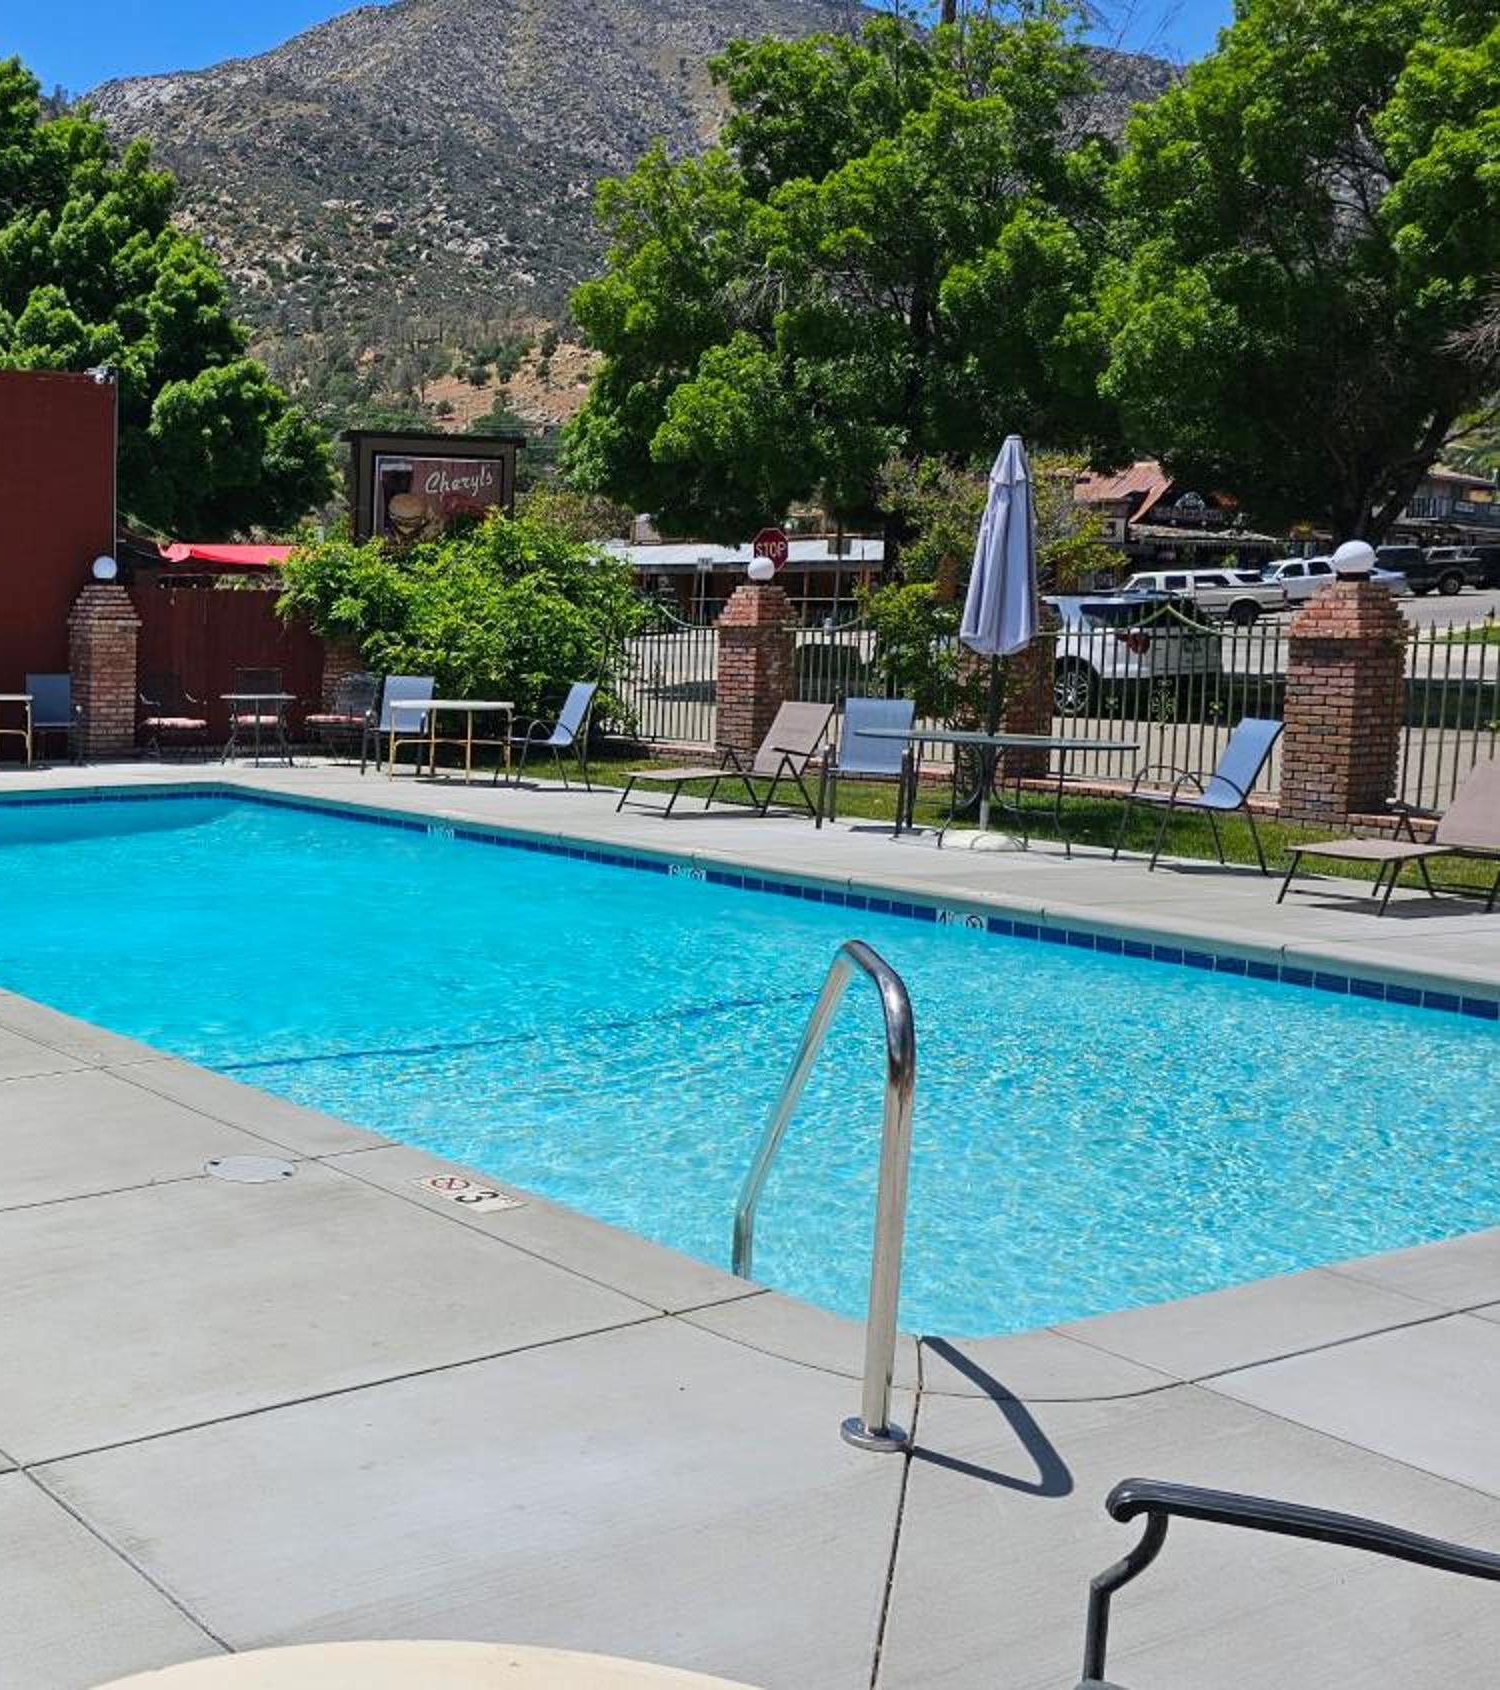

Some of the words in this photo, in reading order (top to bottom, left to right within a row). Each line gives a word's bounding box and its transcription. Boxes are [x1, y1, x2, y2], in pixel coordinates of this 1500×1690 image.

[425, 463, 493, 499] Cheryl's
[755, 541, 787, 557] STOP
[454, 1191, 500, 1203] 3
